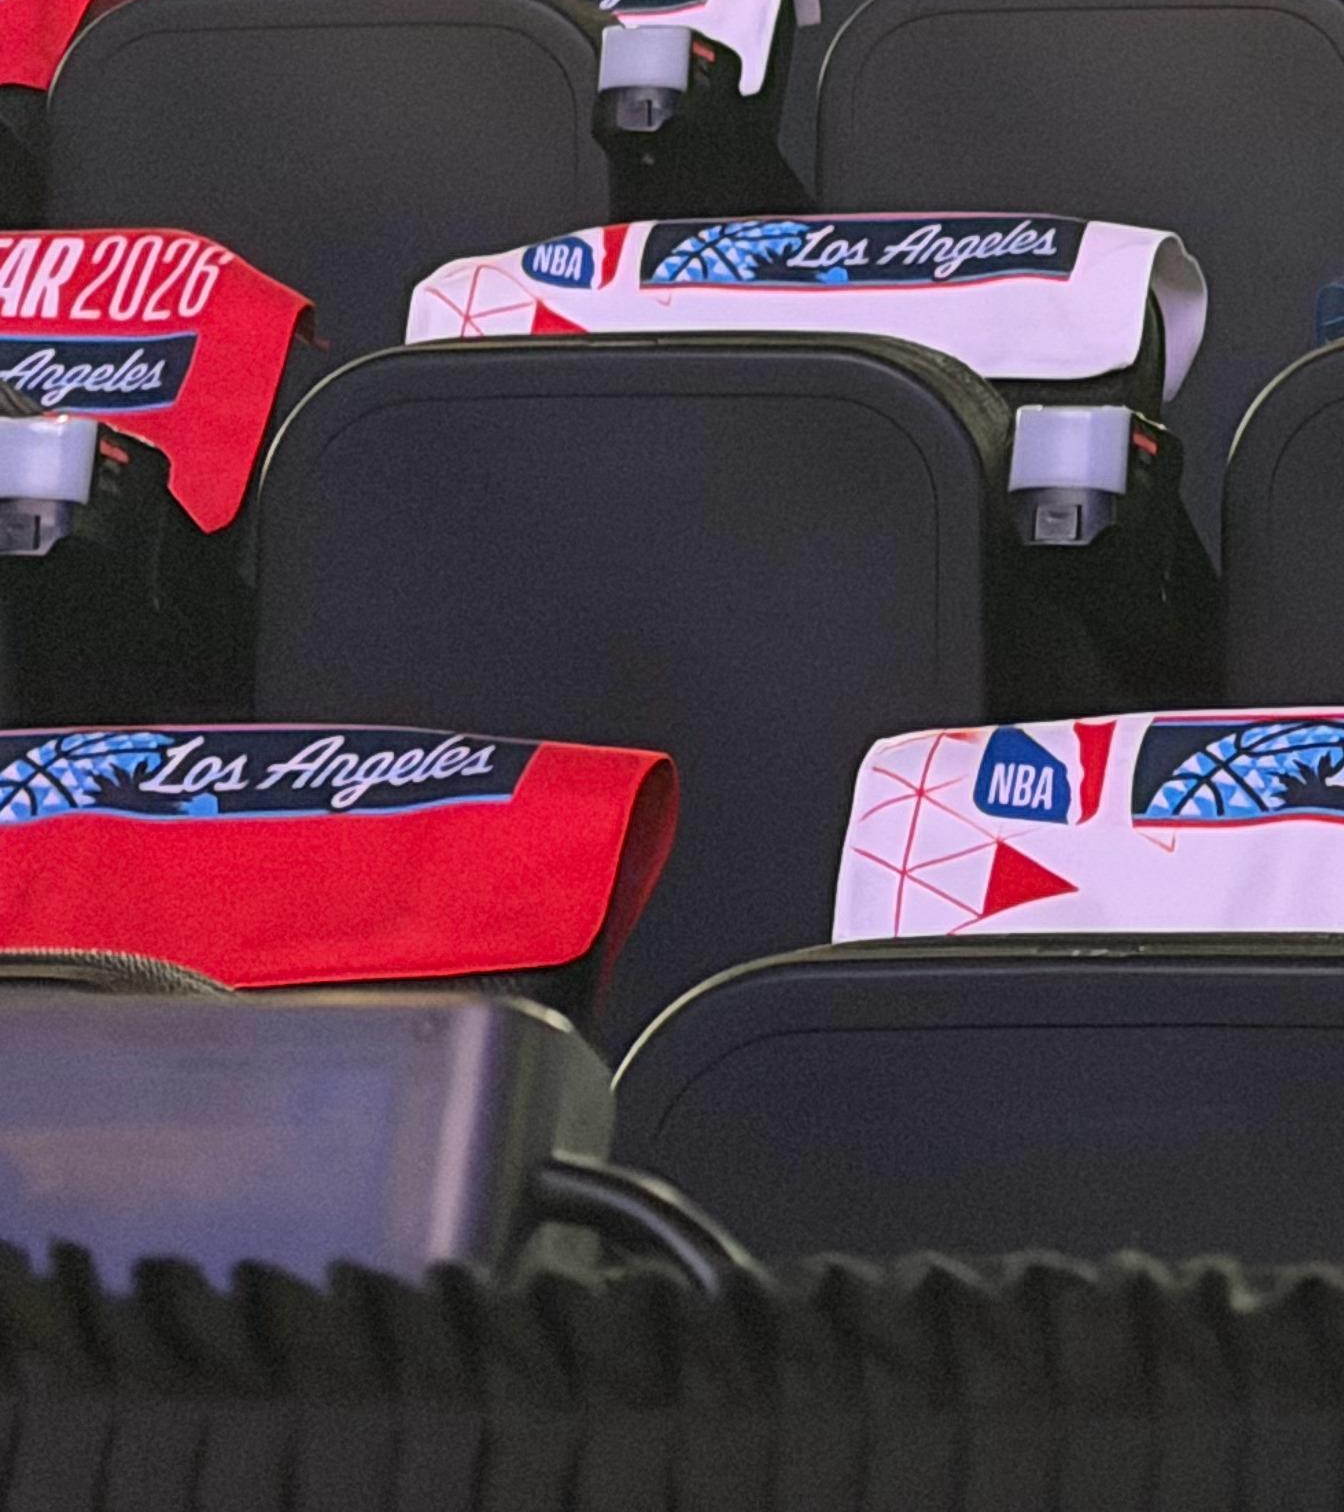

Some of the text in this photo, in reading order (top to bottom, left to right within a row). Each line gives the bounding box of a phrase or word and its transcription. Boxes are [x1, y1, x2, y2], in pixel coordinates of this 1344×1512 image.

[69, 234, 235, 322] 2026
[531, 246, 583, 284] NBA
[786, 217, 1059, 281] Los Angeles
[0, 348, 166, 408] Angeles
[141, 733, 498, 810] Los Angeles
[988, 762, 1054, 812] NBA
